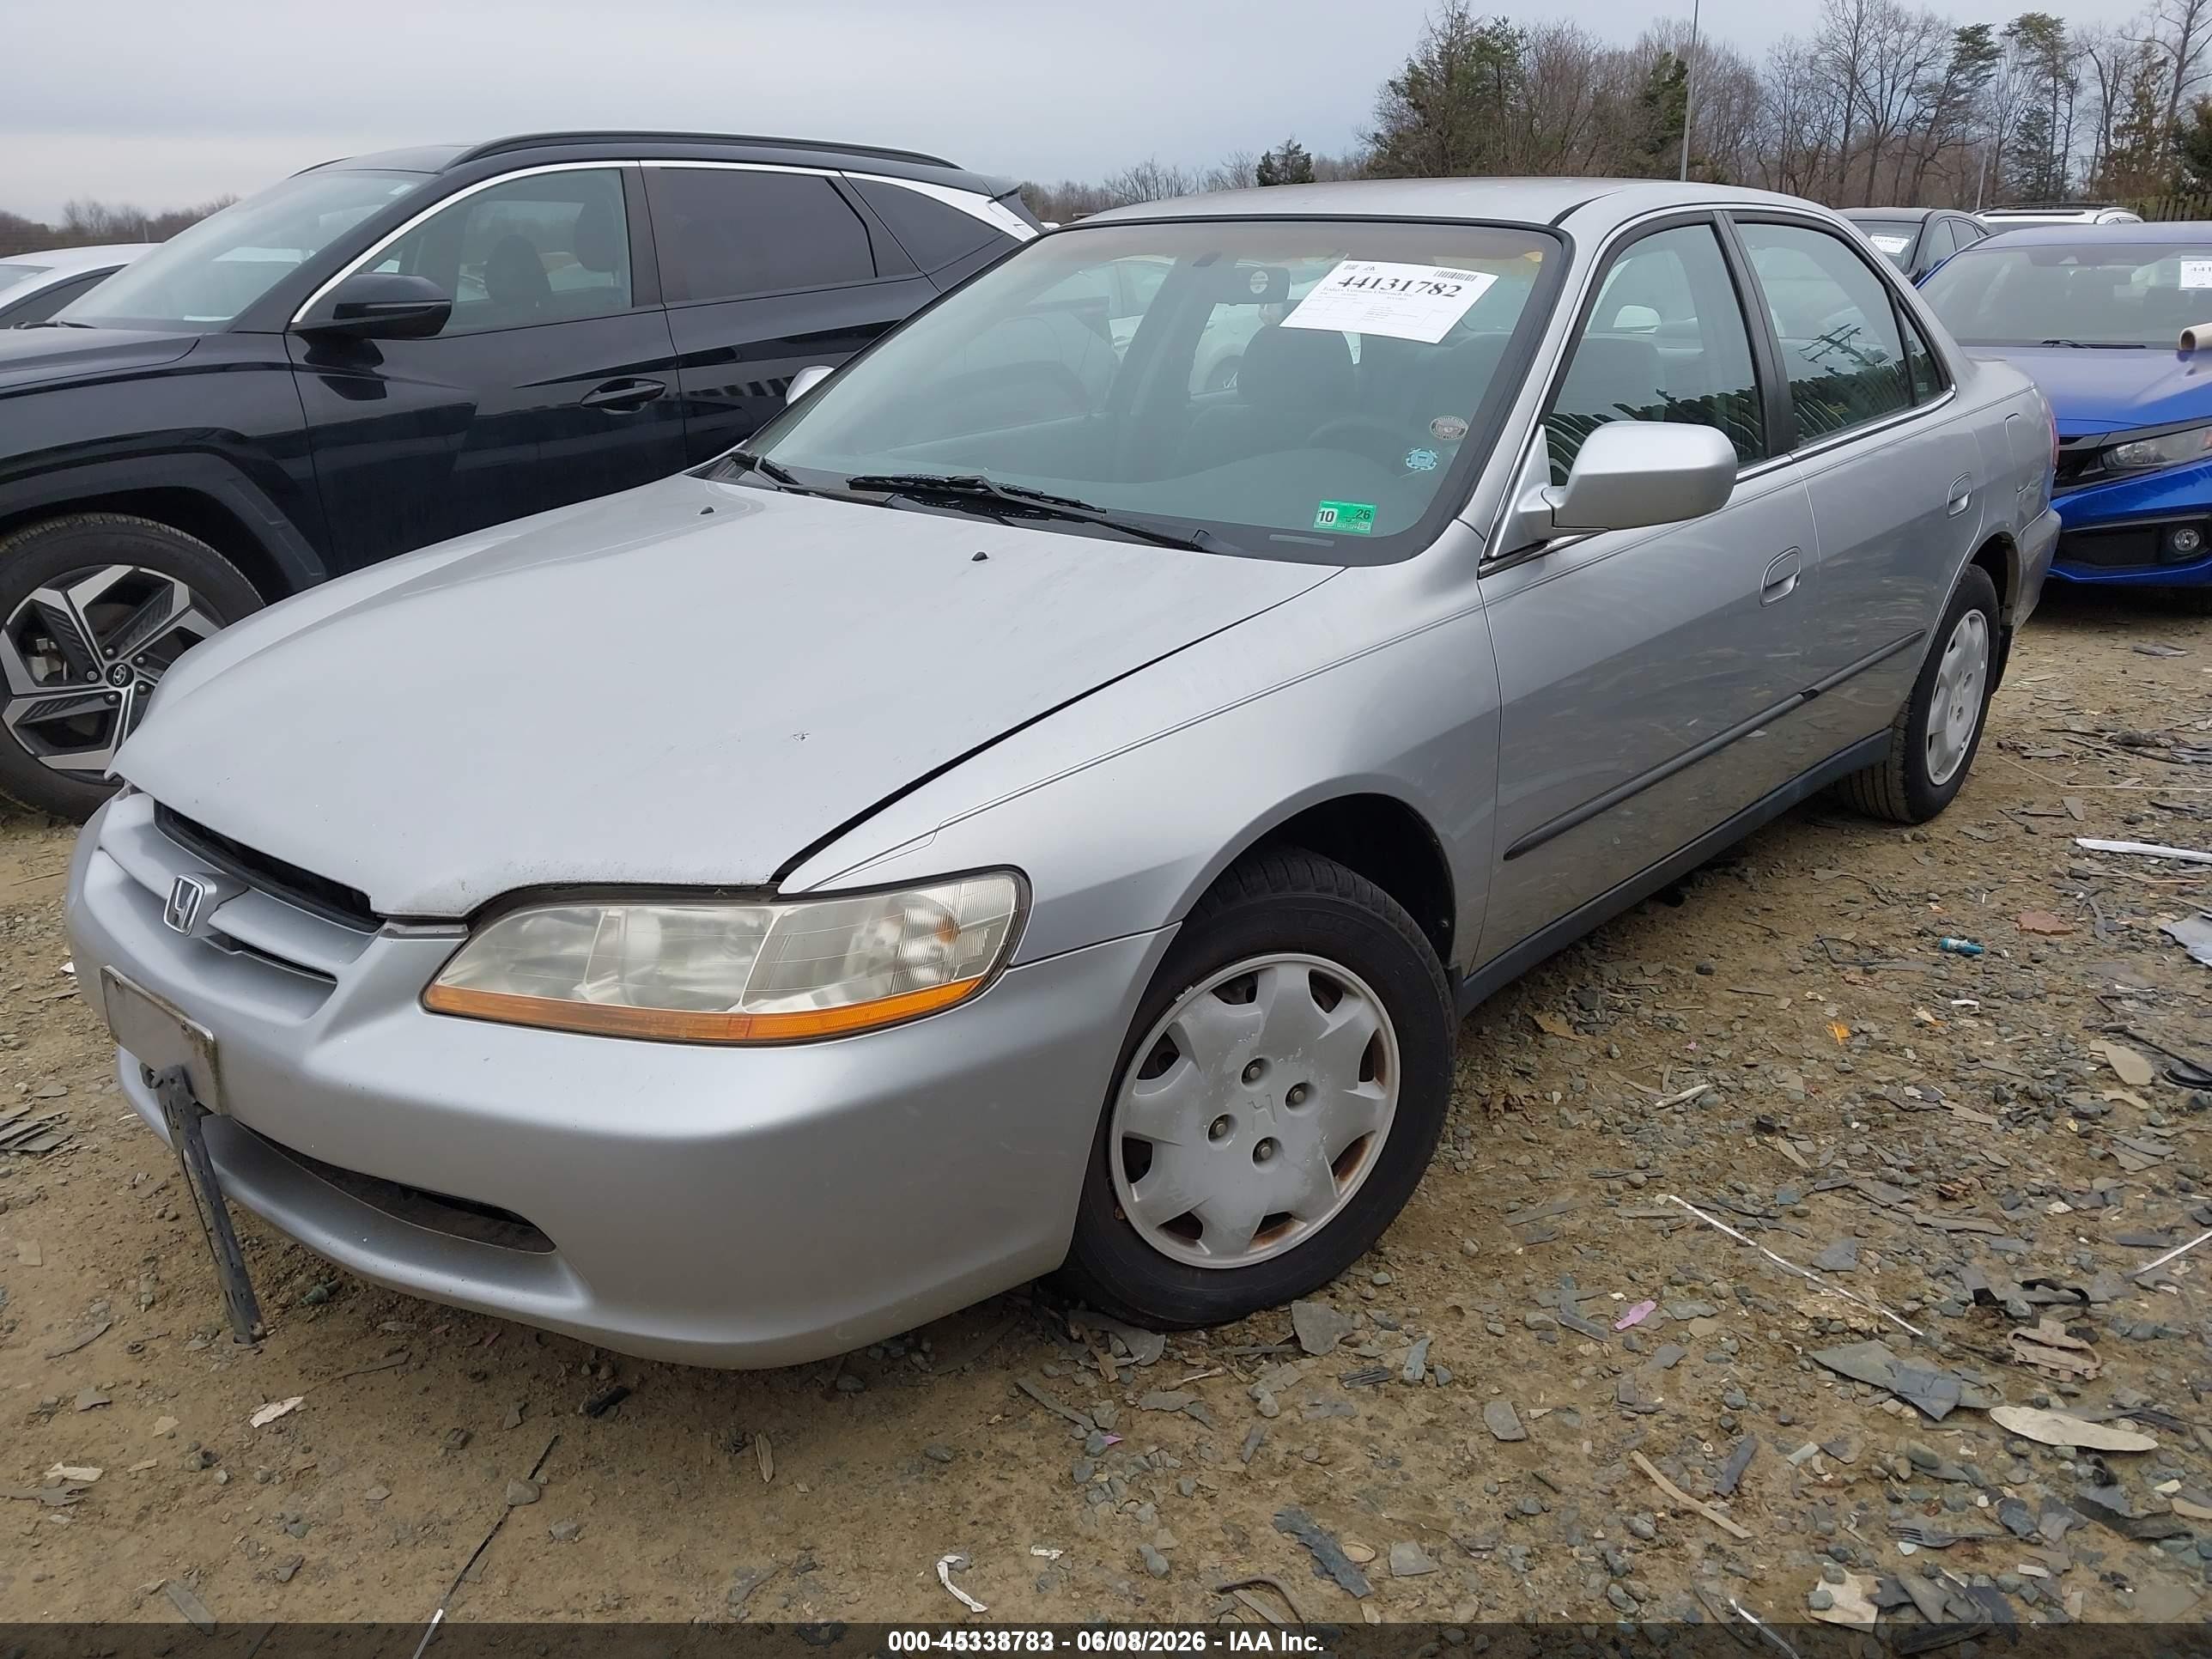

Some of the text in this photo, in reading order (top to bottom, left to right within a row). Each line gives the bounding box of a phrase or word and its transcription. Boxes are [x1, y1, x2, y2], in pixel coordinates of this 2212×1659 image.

[1337, 275, 1463, 298] 44131782
[1318, 510, 1335, 523] 10
[1356, 508, 1372, 520] 26
